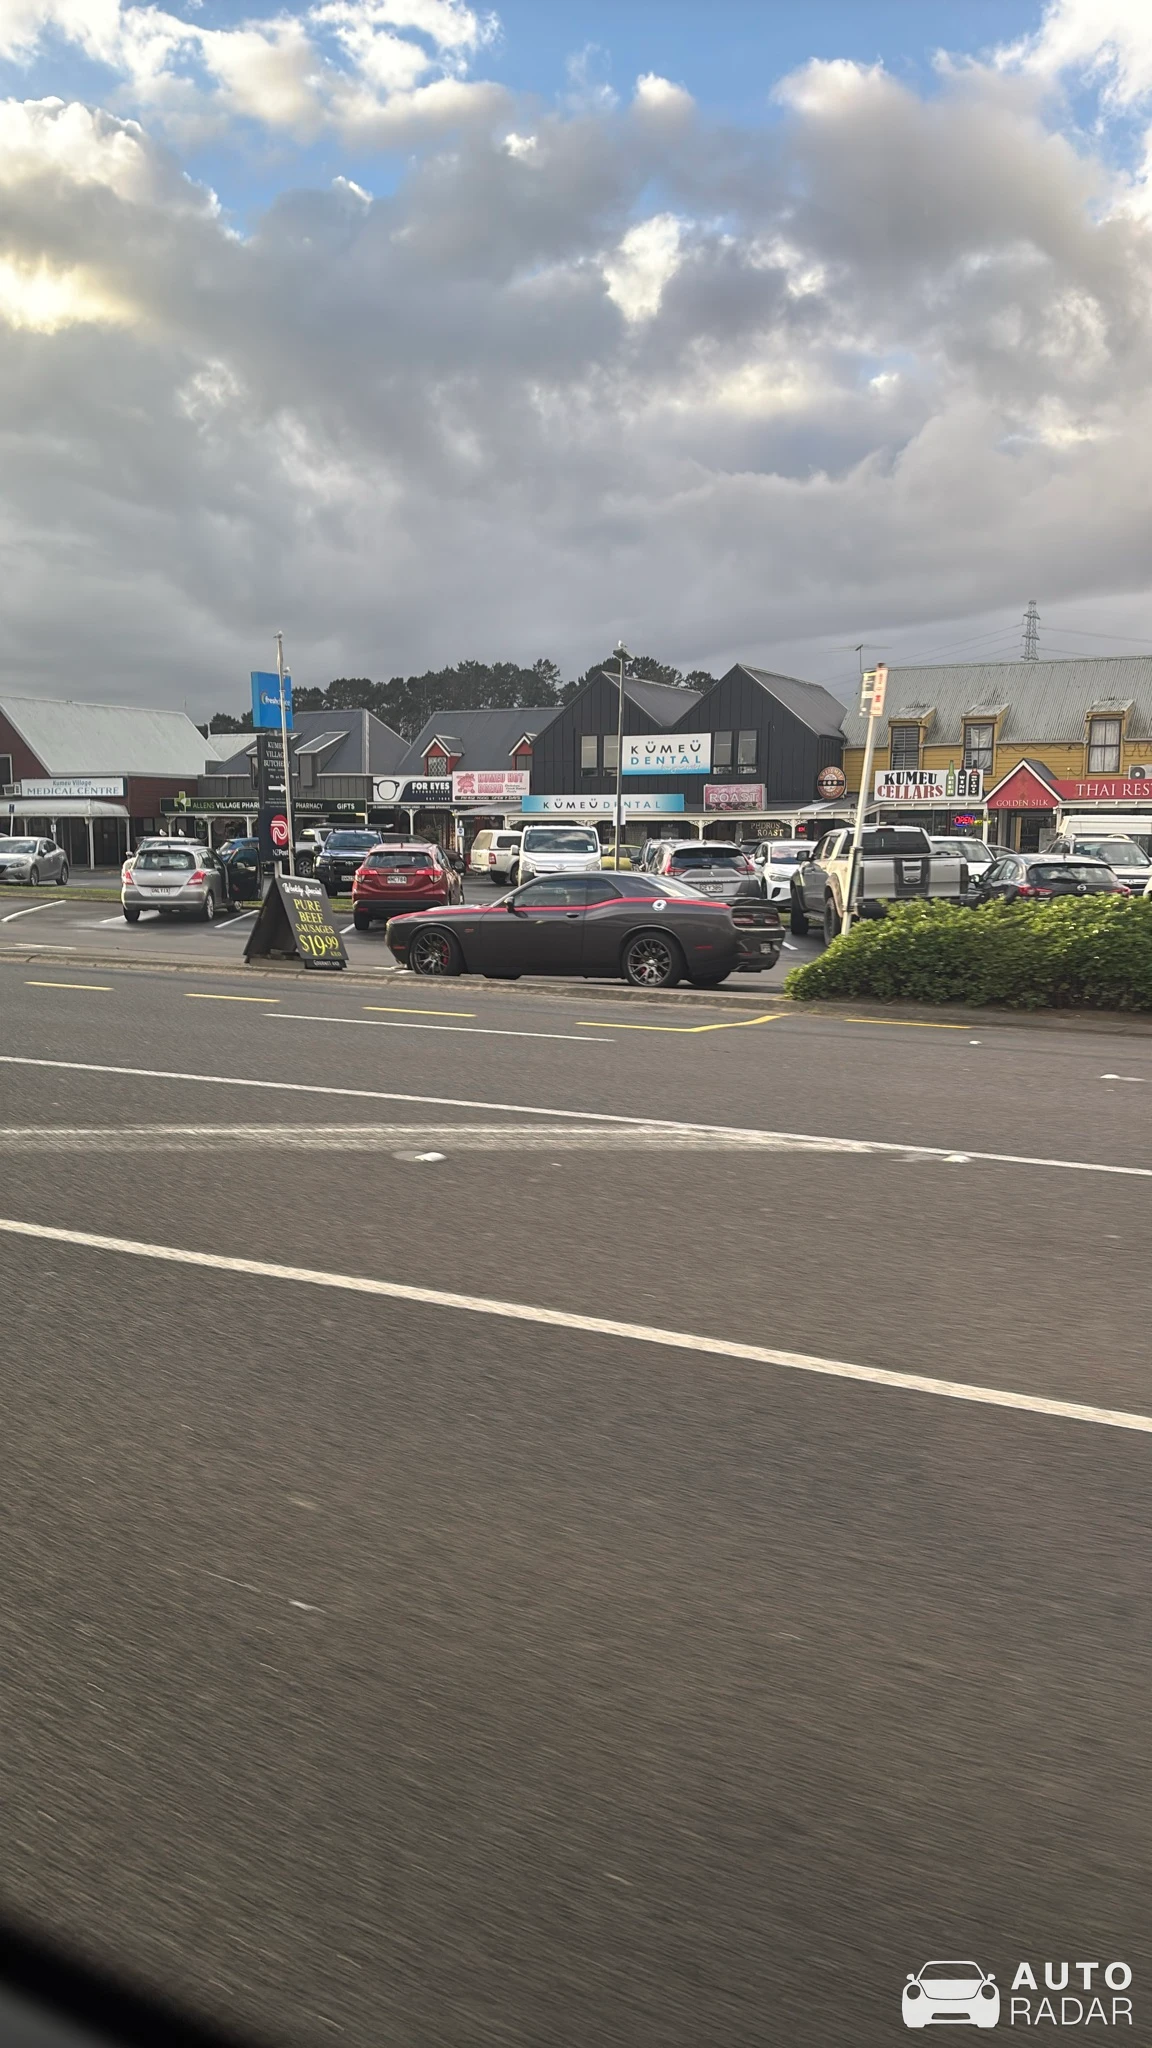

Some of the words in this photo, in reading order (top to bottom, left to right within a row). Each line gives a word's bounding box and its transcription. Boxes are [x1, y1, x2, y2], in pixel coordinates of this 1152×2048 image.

[267, 741, 284, 749] KUME
[631, 755, 701, 765] DENTAL
[884, 771, 938, 785] KUMEU
[412, 782, 429, 790] FOR
[430, 782, 450, 790] EYES
[1076, 783, 1115, 796] THAI
[77, 787, 119, 795] CENTRE
[877, 784, 943, 799] CELLARS
[709, 793, 758, 802] ROAST
[603, 801, 661, 809] DNTAL
[996, 799, 1029, 807] GOLDEN
[954, 815, 974, 824] OPEN
[757, 829, 784, 837] ROAST
[293, 899, 322, 911] PURE
[298, 911, 323, 923] BEEF
[295, 923, 335, 934] SAUSAGES
